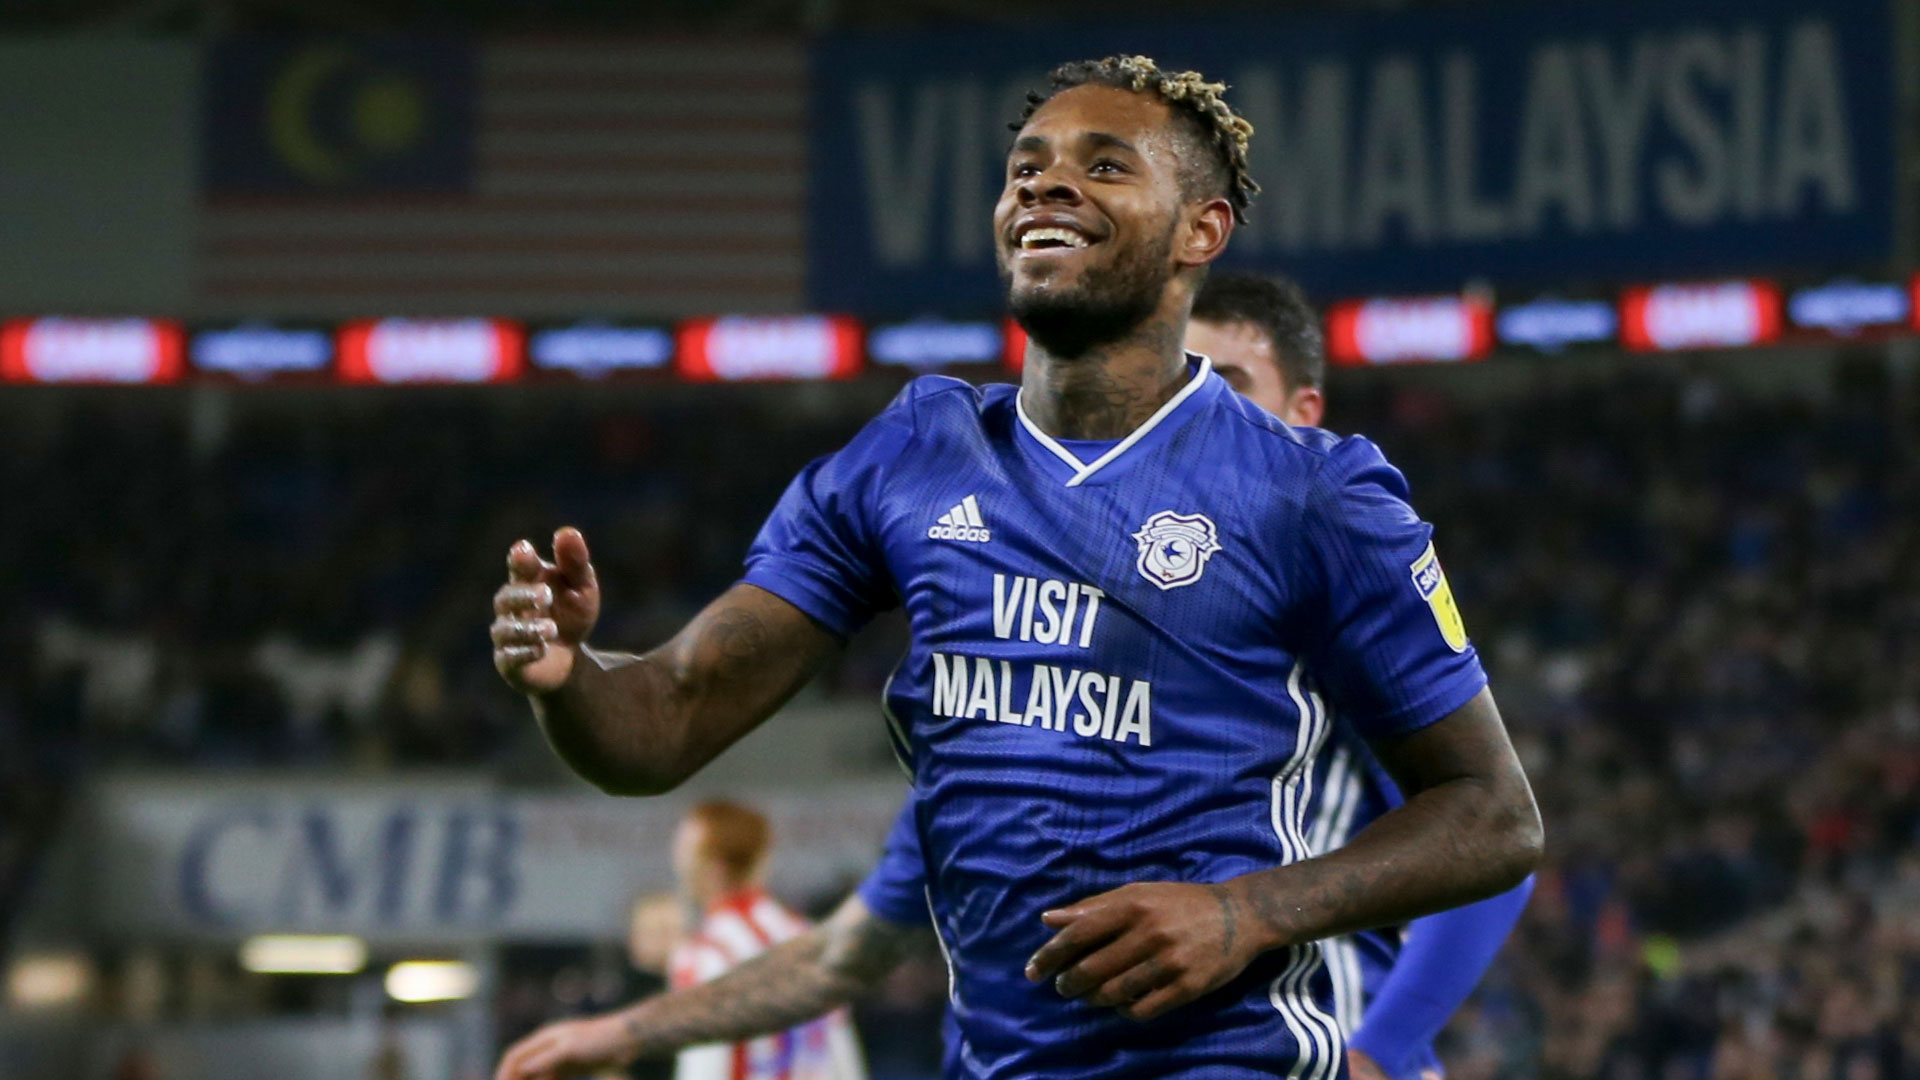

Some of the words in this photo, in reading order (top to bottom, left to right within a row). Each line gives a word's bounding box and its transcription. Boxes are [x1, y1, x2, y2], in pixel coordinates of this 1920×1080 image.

[1244, 22, 1858, 256] MALAYSIA
[928, 524, 990, 543] adidas
[993, 574, 1105, 648] VISIT
[932, 653, 1152, 747] MALAYSIA
[177, 801, 519, 931] CMB
